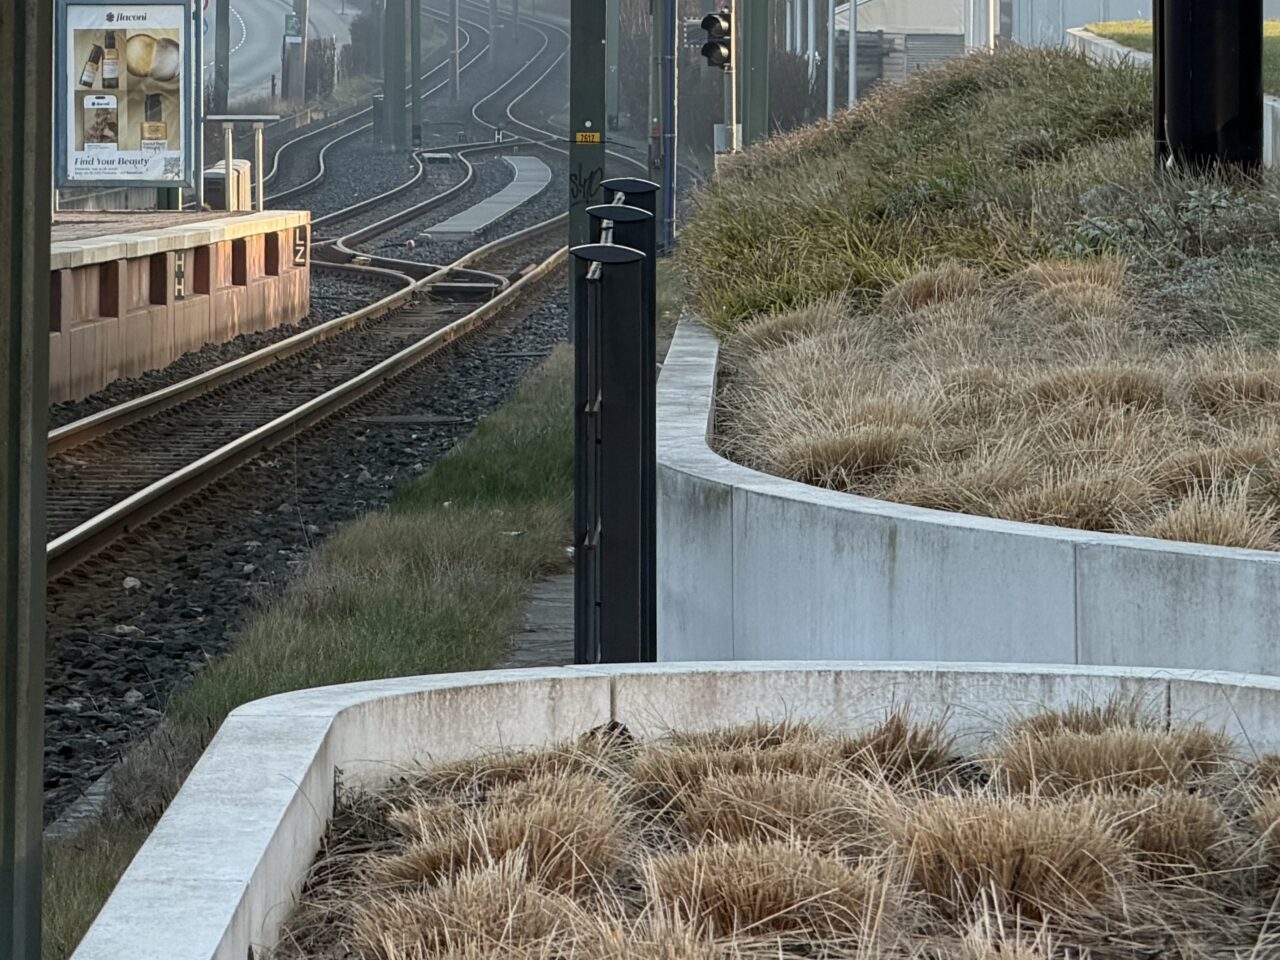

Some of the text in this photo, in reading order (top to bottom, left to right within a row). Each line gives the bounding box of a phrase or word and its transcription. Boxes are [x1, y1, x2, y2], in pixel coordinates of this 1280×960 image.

[116, 12, 147, 22] flaconi
[494, 129, 503, 143] H
[74, 157, 149, 167] Find Your Beauty
